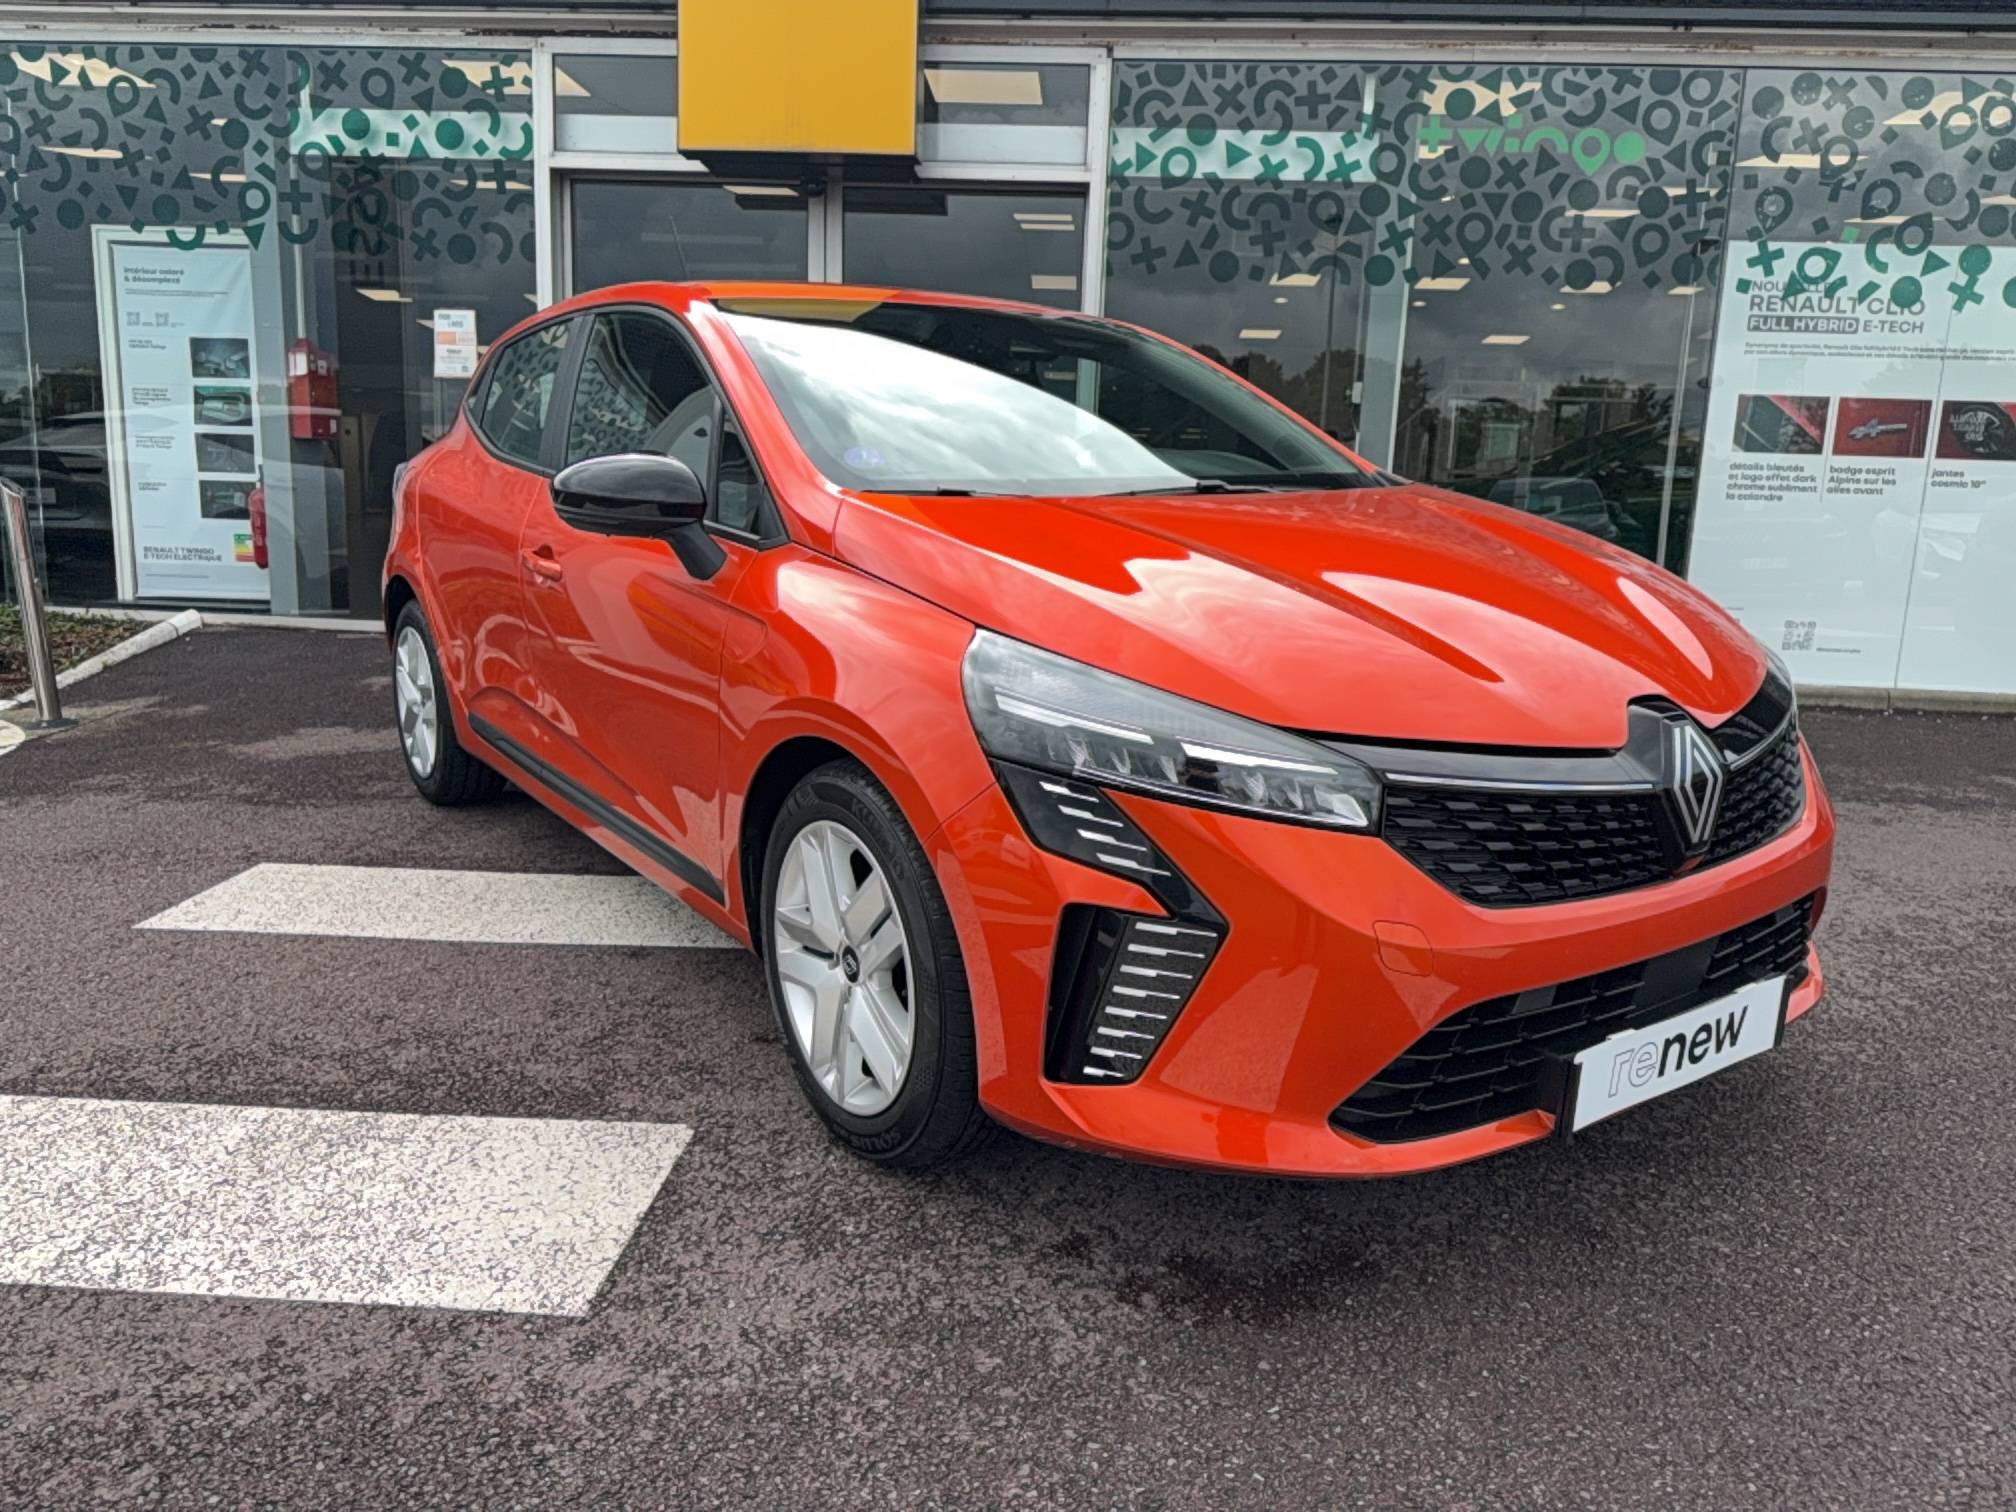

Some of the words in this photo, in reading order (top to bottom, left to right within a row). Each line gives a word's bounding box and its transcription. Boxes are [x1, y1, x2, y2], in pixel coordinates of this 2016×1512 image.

[1750, 294, 1857, 314] RENAULT
[1750, 318, 1790, 331] FULL
[1793, 318, 1857, 332] HYBRID
[1863, 320, 1925, 333] E-TECH
[1829, 465, 1863, 476] badge
[1865, 466, 1896, 476] esprit
[1931, 468, 1965, 479] jantes
[1741, 472, 1763, 482] logo
[1765, 473, 1790, 481] effet
[1792, 474, 1816, 482] dark
[1828, 475, 1861, 484] Alpine
[1727, 482, 1765, 491] chrome
[1852, 487, 1883, 495] avant
[1607, 1004, 1749, 1099] renew
